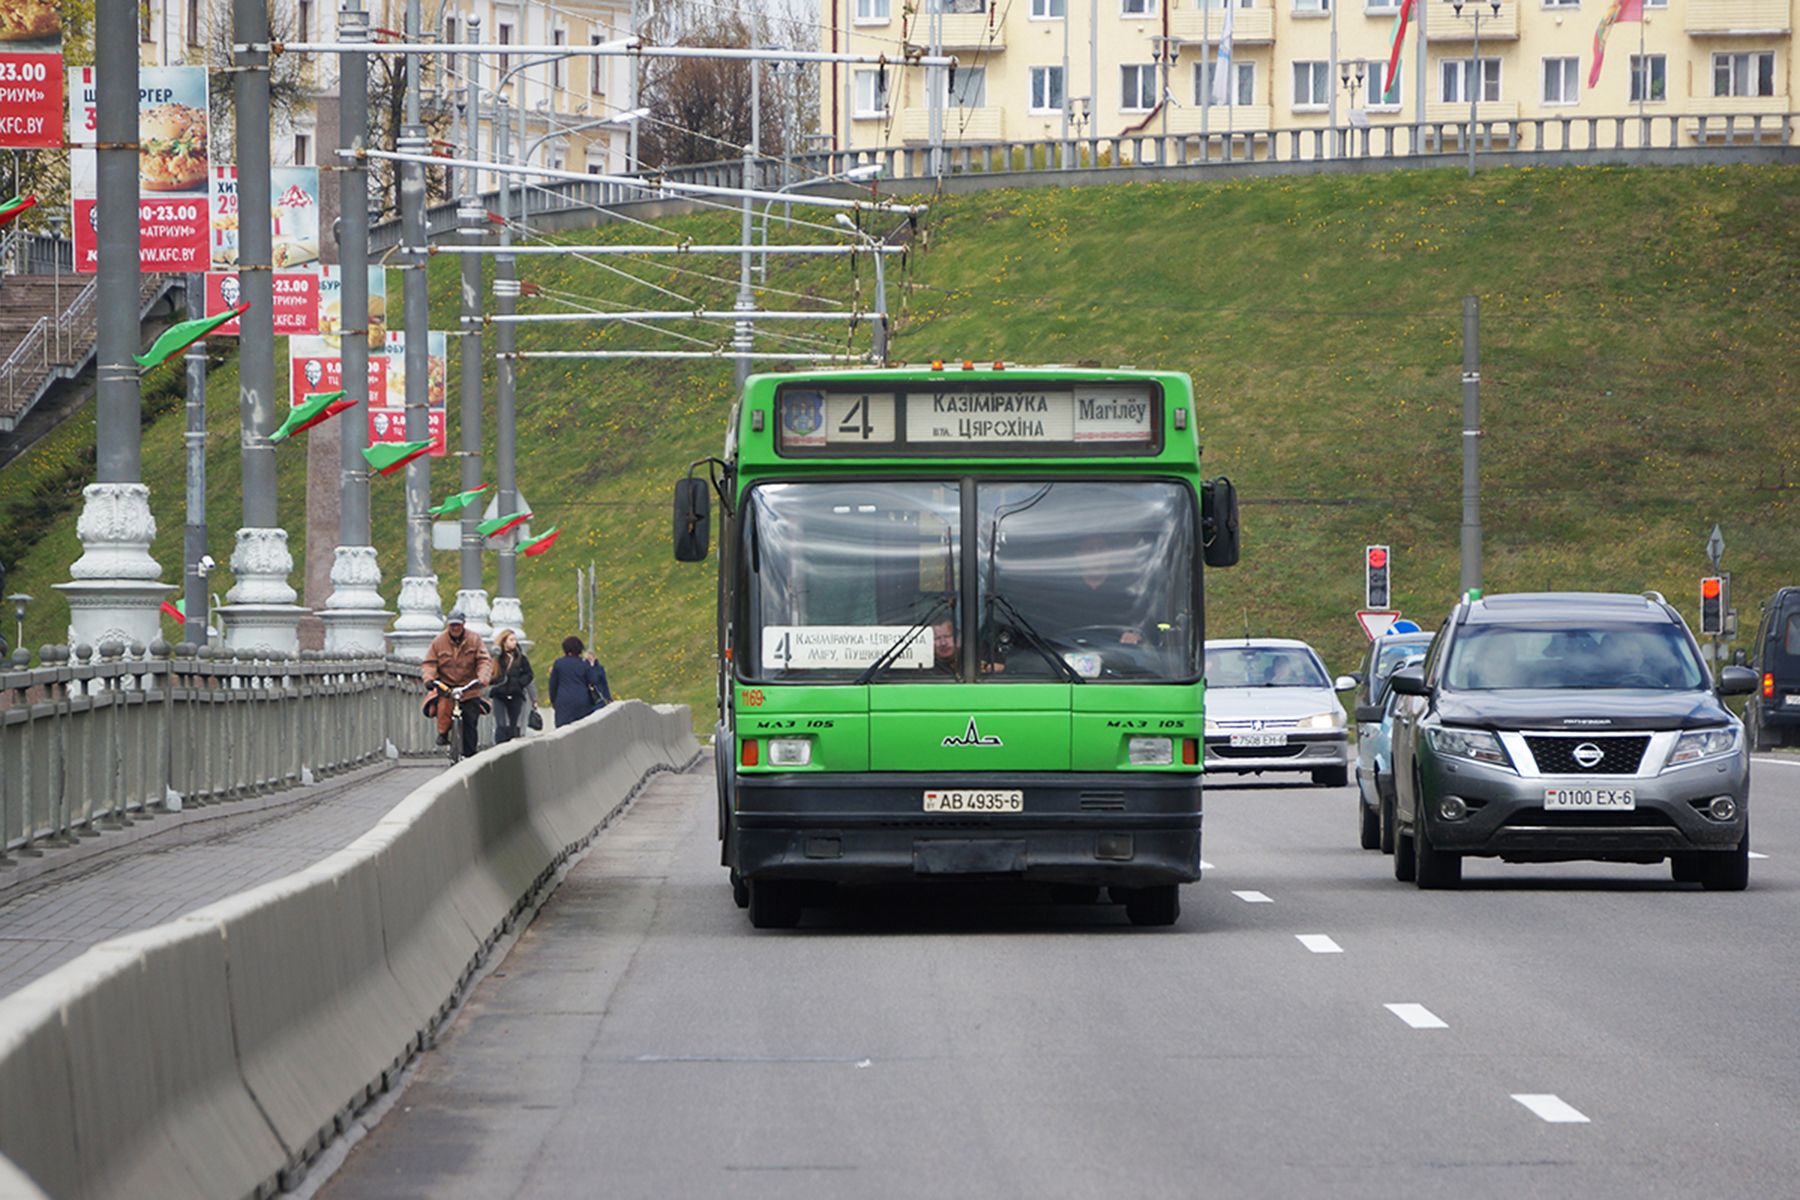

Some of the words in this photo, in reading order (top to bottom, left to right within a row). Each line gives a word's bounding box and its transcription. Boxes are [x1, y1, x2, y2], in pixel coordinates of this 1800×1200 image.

[140, 225, 196, 239] «АТРИУМ»
[272, 296, 308, 306] ТРИУМ»
[838, 395, 874, 440] 4
[774, 632, 793, 662] 4
[756, 720, 797, 729] МАЗ
[806, 719, 835, 728] 105
[1105, 720, 1148, 728] МАЗ
[1158, 720, 1185, 728] 105
[939, 793, 964, 809] AB
[967, 793, 1021, 809] 4935-6
[1558, 790, 1593, 805] 0100
[1597, 790, 1632, 805] EX-6
